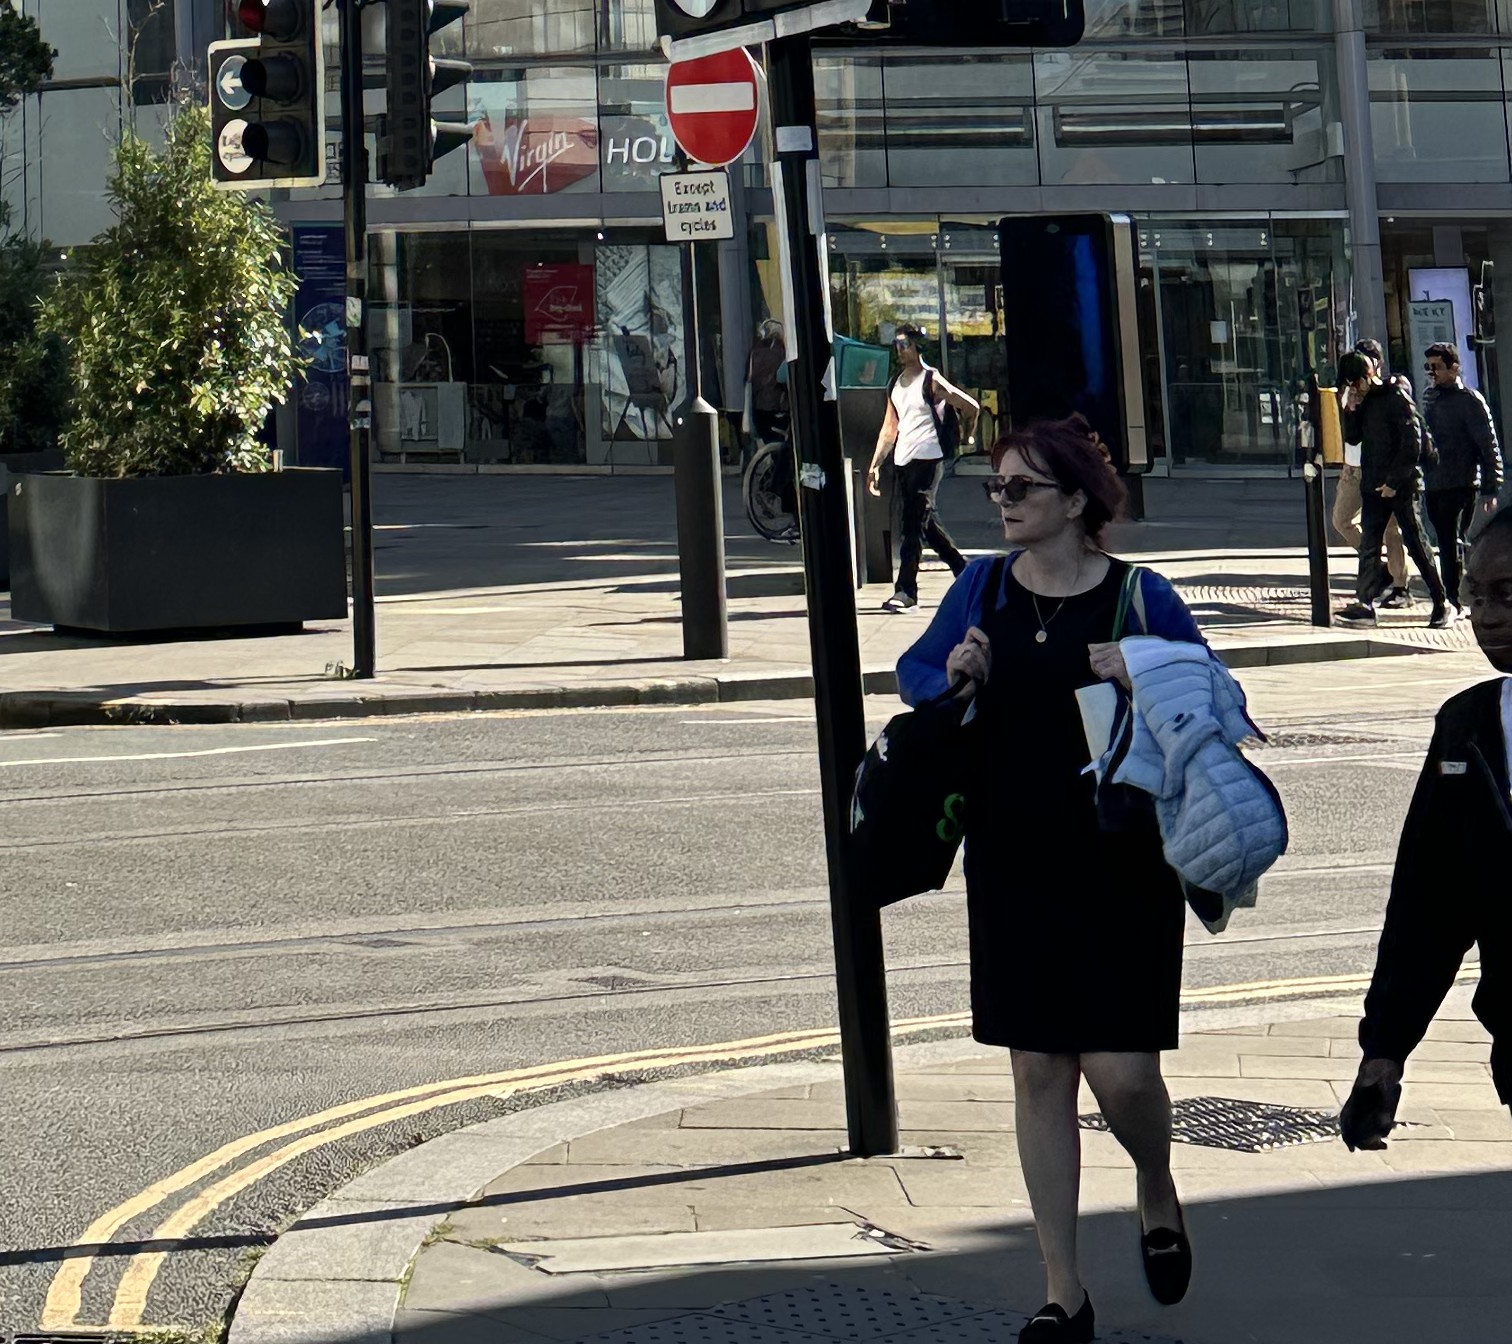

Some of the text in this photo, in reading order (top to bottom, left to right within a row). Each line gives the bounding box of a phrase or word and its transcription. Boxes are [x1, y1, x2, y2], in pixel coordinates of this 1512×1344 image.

[500, 119, 575, 193] Virgin
[674, 180, 715, 196] Except
[667, 197, 727, 214] trams and
[680, 218, 717, 235] cycles
